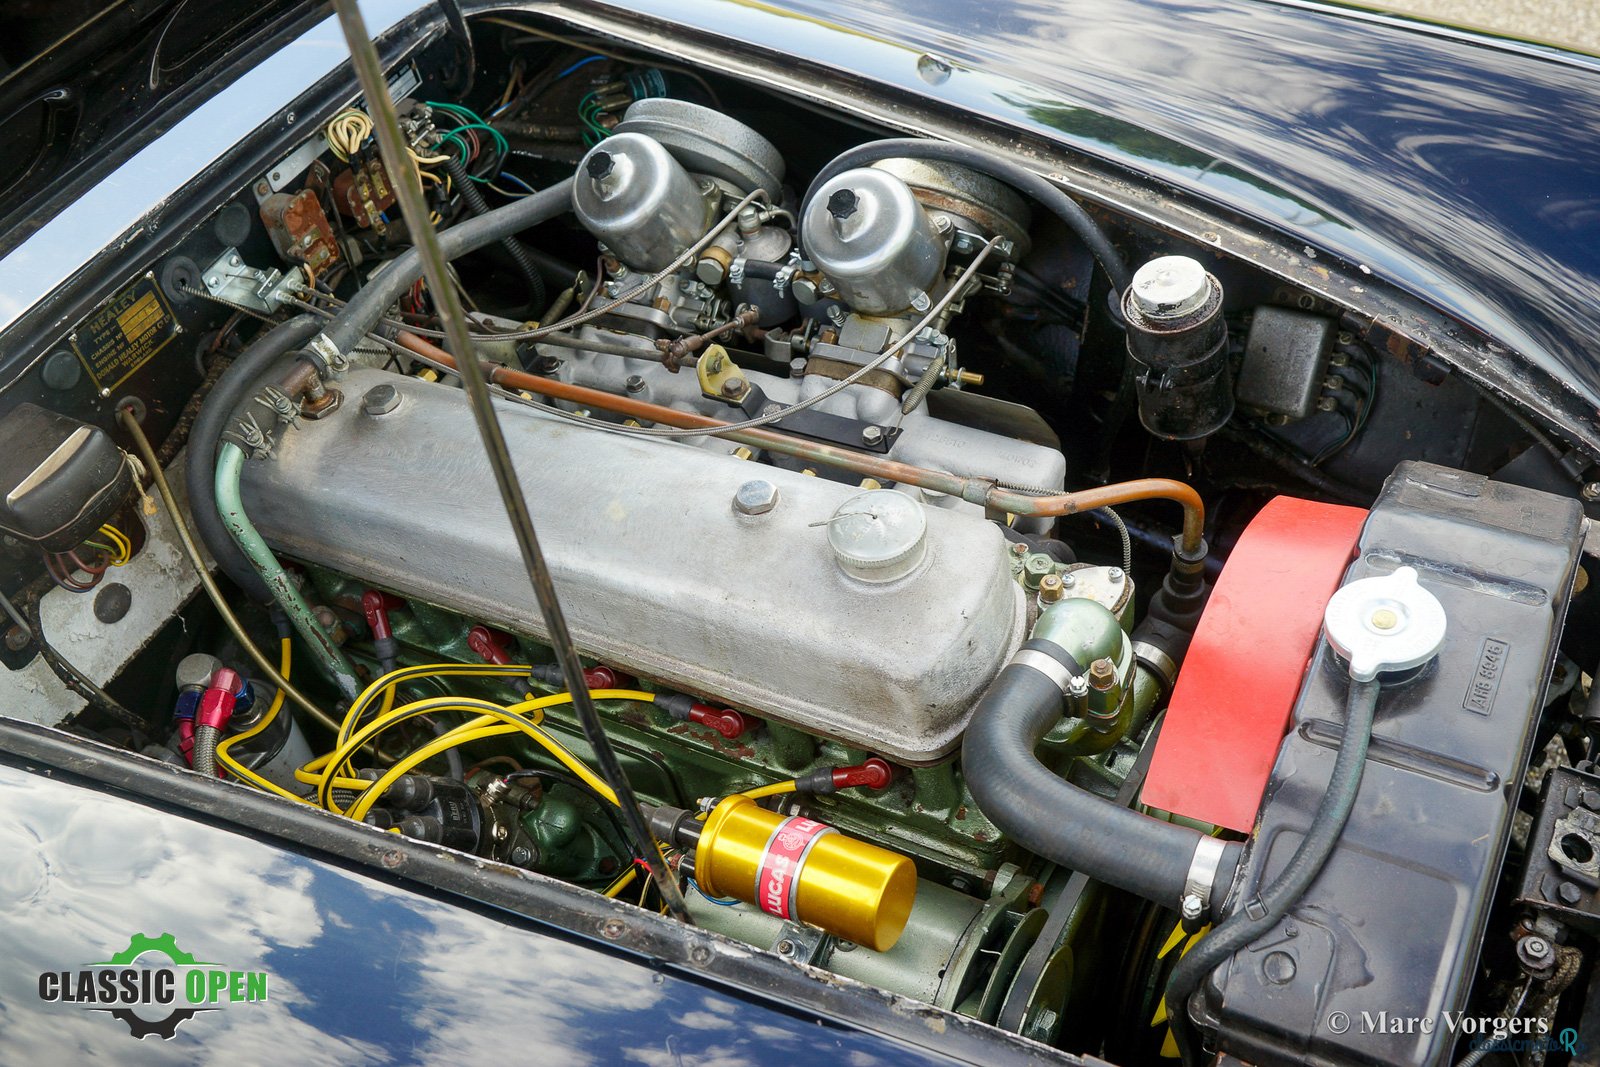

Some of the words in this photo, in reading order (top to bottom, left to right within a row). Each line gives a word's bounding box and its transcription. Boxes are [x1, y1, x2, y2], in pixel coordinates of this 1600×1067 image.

[89, 290, 137, 334] HEALEY
[91, 339, 116, 360] CHASSIS
[96, 358, 119, 380] DONALD
[119, 342, 141, 362] HEALEY
[139, 326, 159, 346] MOTOR
[121, 339, 155, 368] WARWICK
[1471, 682, 1492, 709] AHB
[767, 854, 790, 915] LUCAS
